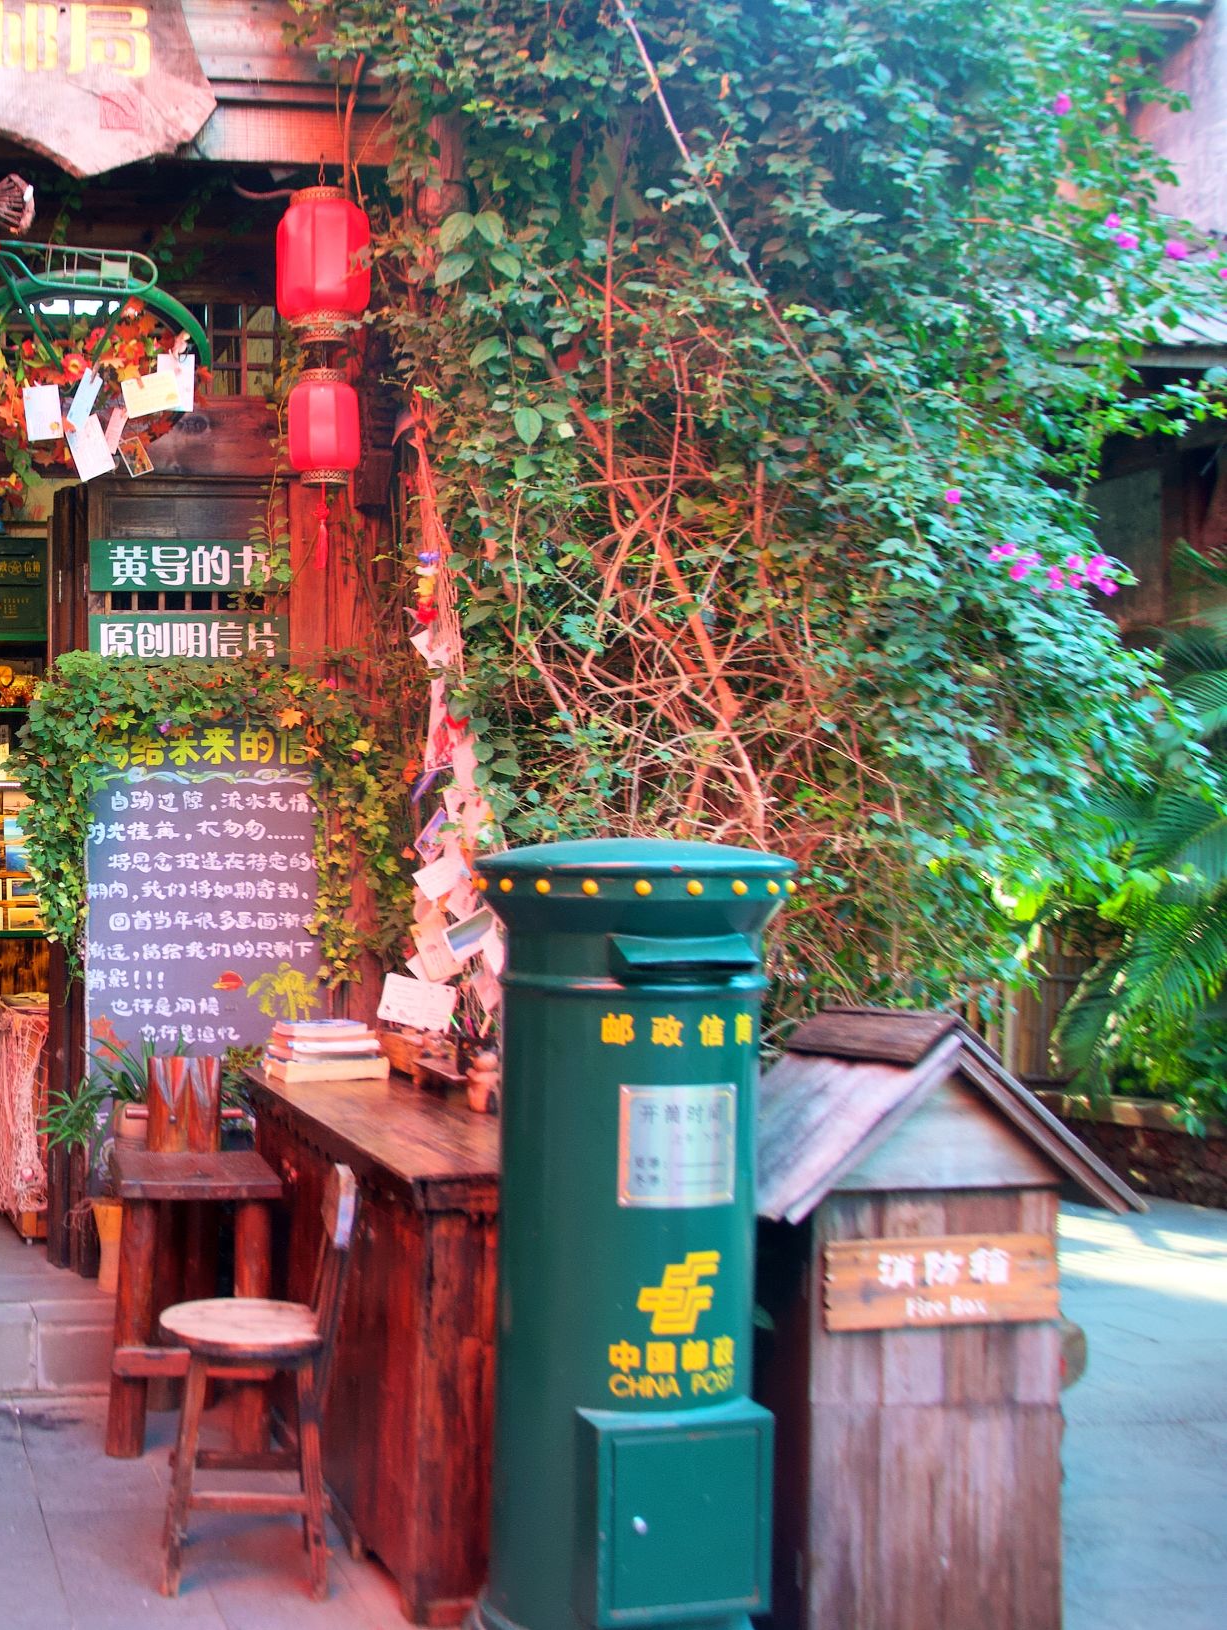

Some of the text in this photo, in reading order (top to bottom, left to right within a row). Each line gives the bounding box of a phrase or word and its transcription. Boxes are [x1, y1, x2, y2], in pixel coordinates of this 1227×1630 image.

[99, 621, 280, 658] 原创明信片
[110, 996, 220, 1017] 也许是问候
[878, 1248, 1011, 1289] 消防箱
[905, 1295, 988, 1318] Fire Box
[608, 1334, 735, 1374] 中国邮政
[608, 1373, 682, 1398] CHINA
